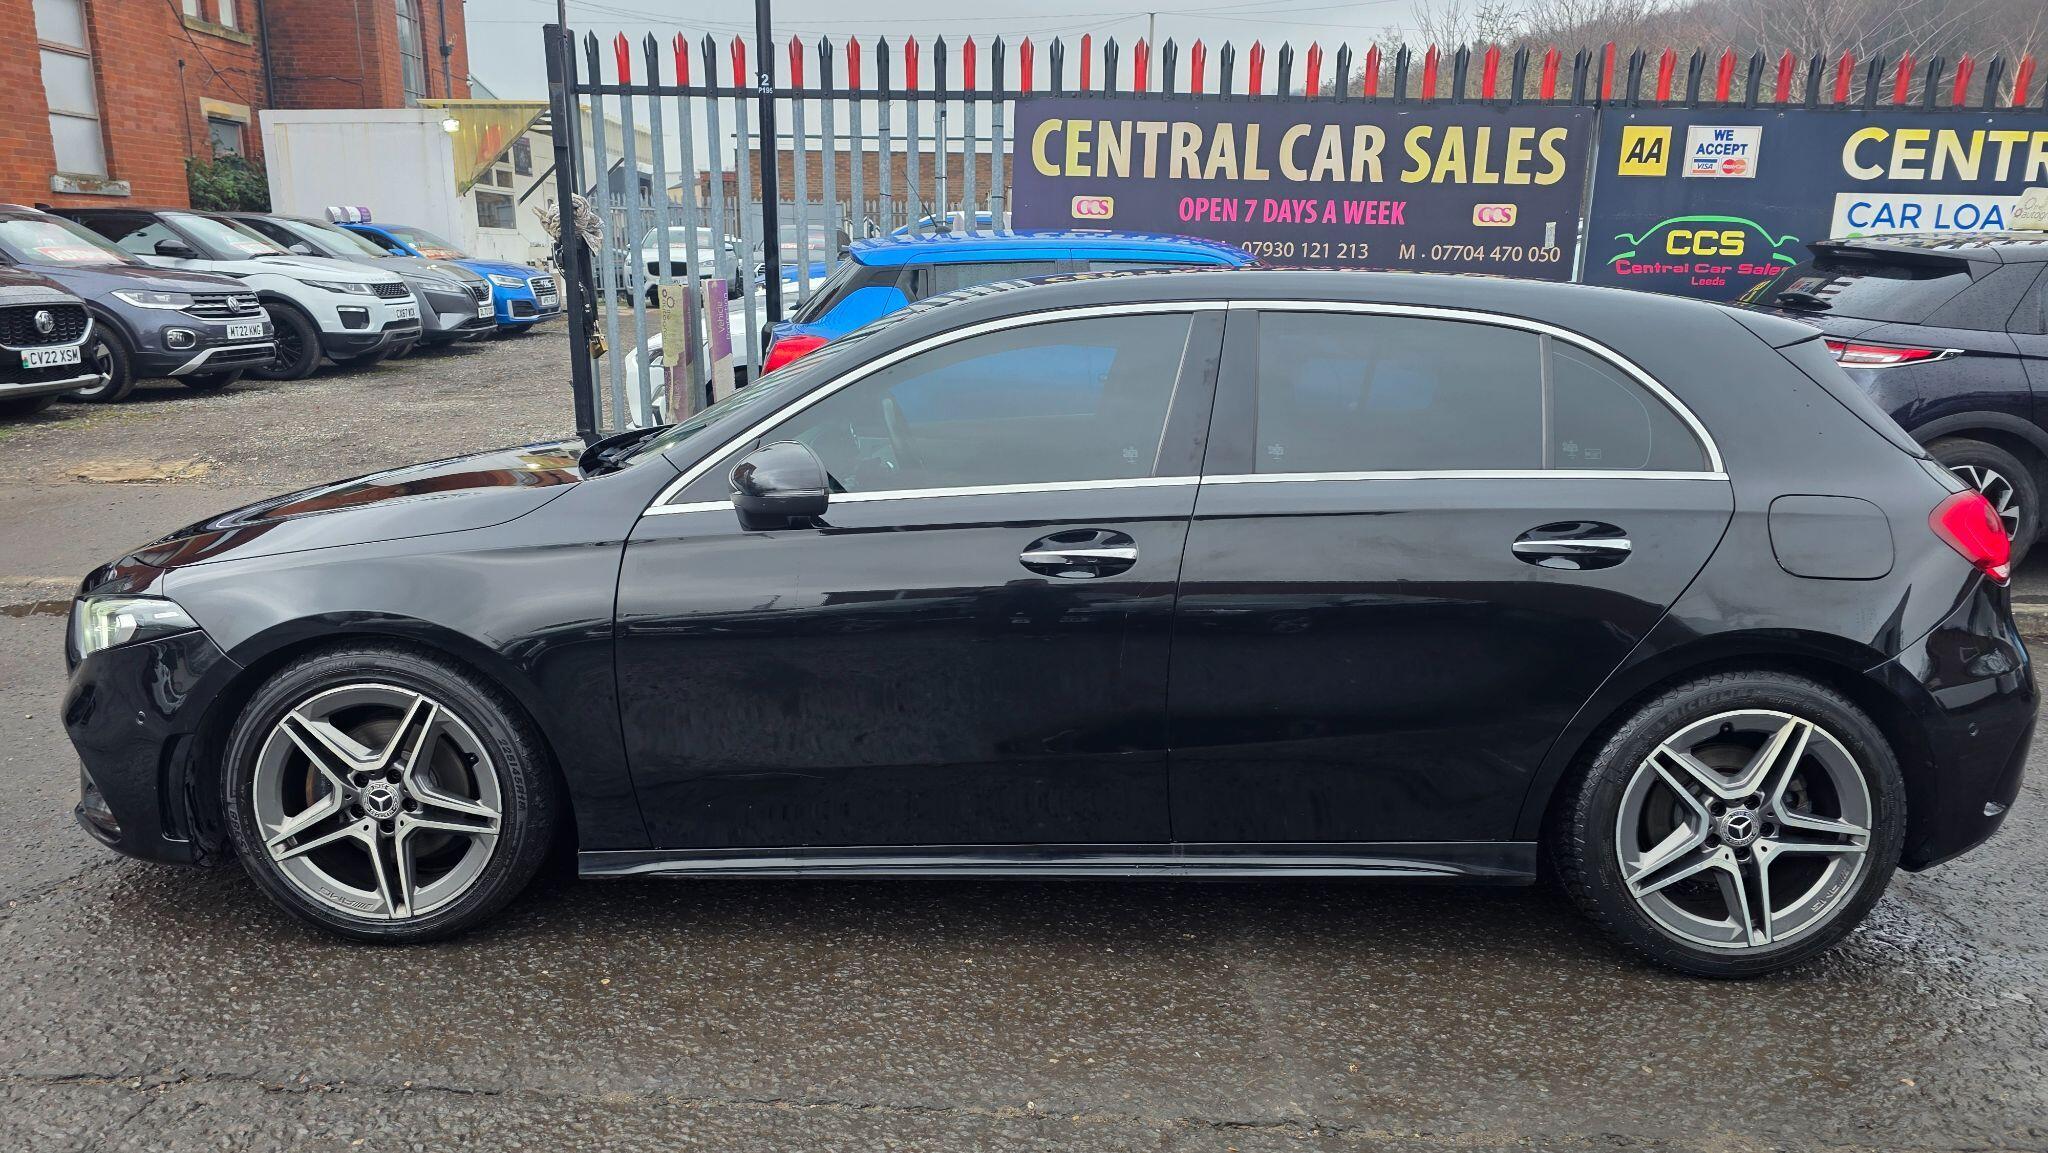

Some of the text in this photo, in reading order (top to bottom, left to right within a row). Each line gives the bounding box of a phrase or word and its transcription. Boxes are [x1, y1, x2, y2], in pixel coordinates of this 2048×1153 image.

[761, 73, 770, 86] 2
[1714, 129, 1734, 141] WE
[1032, 119, 1567, 186] CENTRAL CAR SALES
[1625, 138, 1663, 164] AA
[1696, 143, 1748, 155] ACCEPT
[1076, 199, 1109, 215] CCS
[1179, 197, 1406, 225] OPEN 7 DAYS A WEEK
[1477, 206, 1512, 223] CCS
[1846, 202, 1924, 230] CAR
[1933, 202, 2016, 231] LOA
[1241, 241, 1368, 258] 07930 121 213
[1666, 230, 1744, 256] CCS
[1432, 245, 1484, 261] 07704
[1490, 247, 1522, 261] 470
[1529, 247, 1560, 263] 050
[1615, 260, 1690, 276] Central
[1694, 263, 1732, 274] Car
[1691, 276, 1726, 286] Leeds
[229, 326, 249, 337] MT22
[30, 347, 79, 365] CV22 XSM
